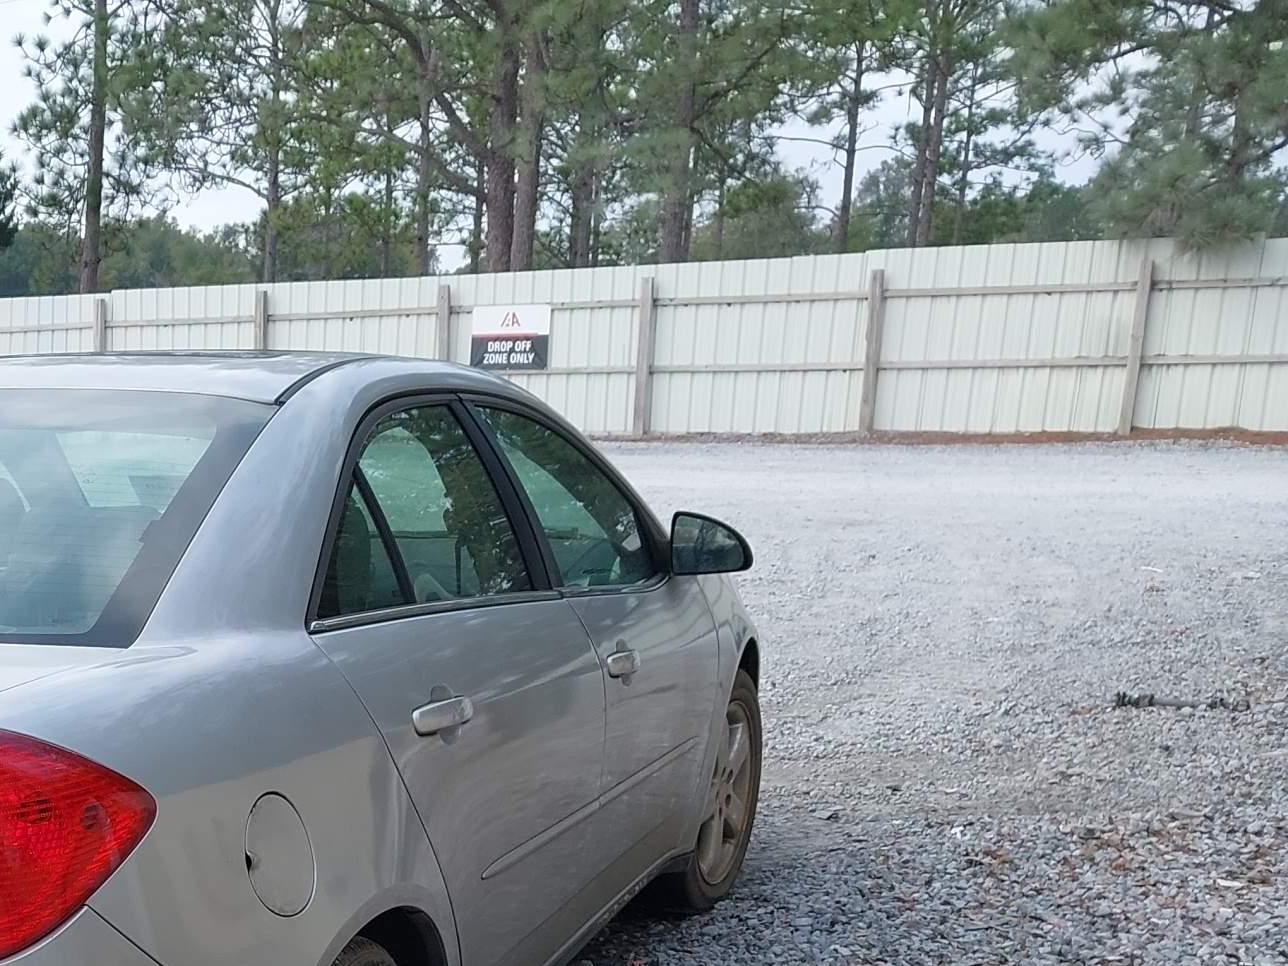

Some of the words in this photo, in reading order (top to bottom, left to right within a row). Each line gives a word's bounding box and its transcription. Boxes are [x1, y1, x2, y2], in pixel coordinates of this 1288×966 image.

[487, 341, 513, 352] DROP
[514, 340, 532, 351] OFF
[483, 353, 508, 364] ZONE
[509, 352, 535, 363] ONLY
